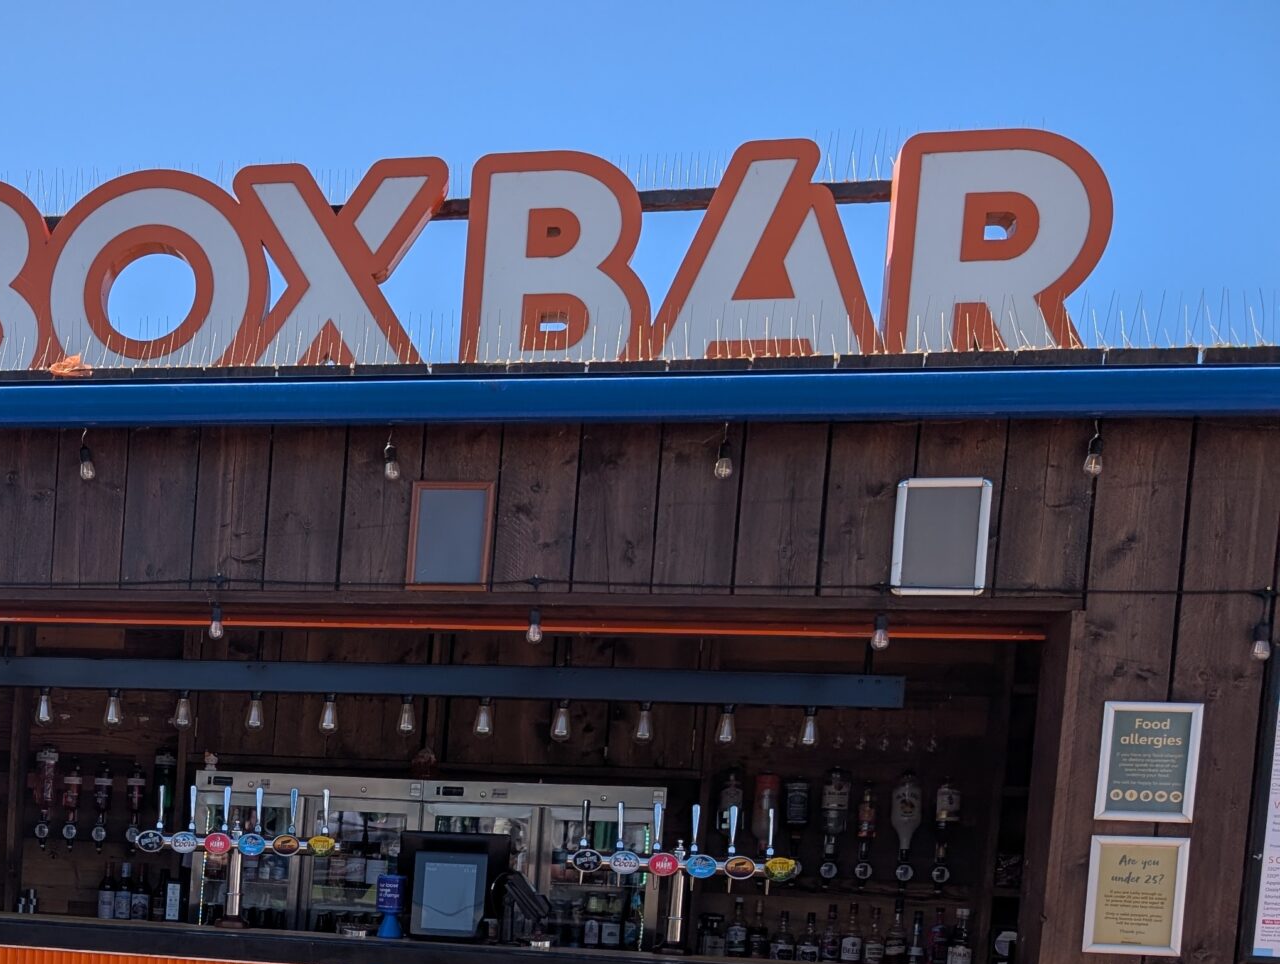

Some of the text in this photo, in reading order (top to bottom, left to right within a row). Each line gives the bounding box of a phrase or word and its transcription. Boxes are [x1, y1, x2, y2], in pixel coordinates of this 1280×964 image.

[463, 128, 1114, 365] BAR
[1135, 718, 1171, 730] Food
[1120, 733, 1182, 748] allergies
[1118, 854, 1160, 870] Are you
[1110, 871, 1165, 885] under 25?
